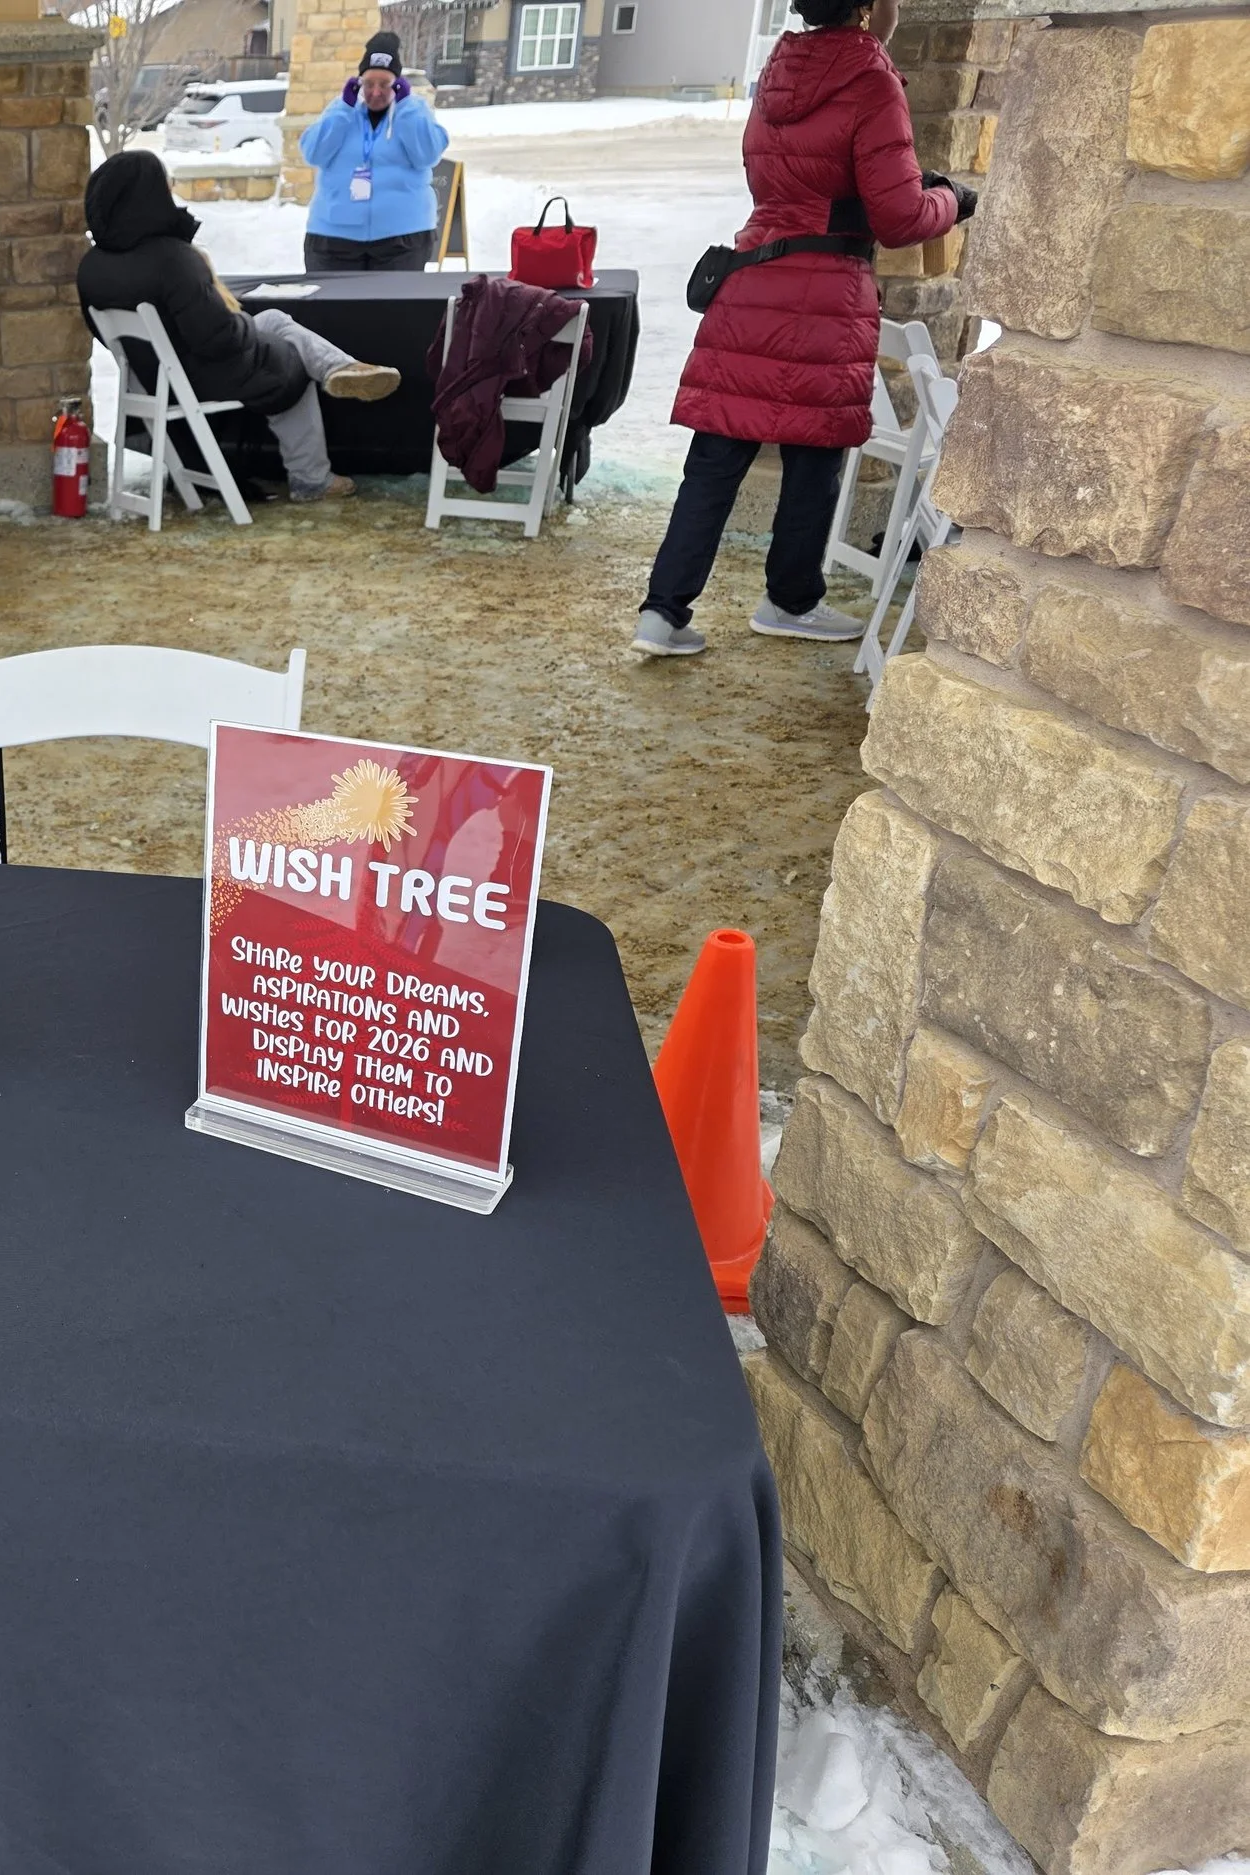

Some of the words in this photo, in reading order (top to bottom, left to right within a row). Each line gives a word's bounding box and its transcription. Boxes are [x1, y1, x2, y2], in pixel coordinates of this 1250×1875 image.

[229, 836, 353, 901] WISH
[368, 861, 510, 931] TREE
[253, 975, 397, 1025] ASPIRATIONS
[407, 1009, 460, 1038] AND
[253, 1028, 344, 1072] DISPLAY
[424, 1071, 453, 1097] TO
[314, 1015, 358, 1044] FOR
[367, 1026, 431, 1062] 2026
[440, 1048, 493, 1077] AND
